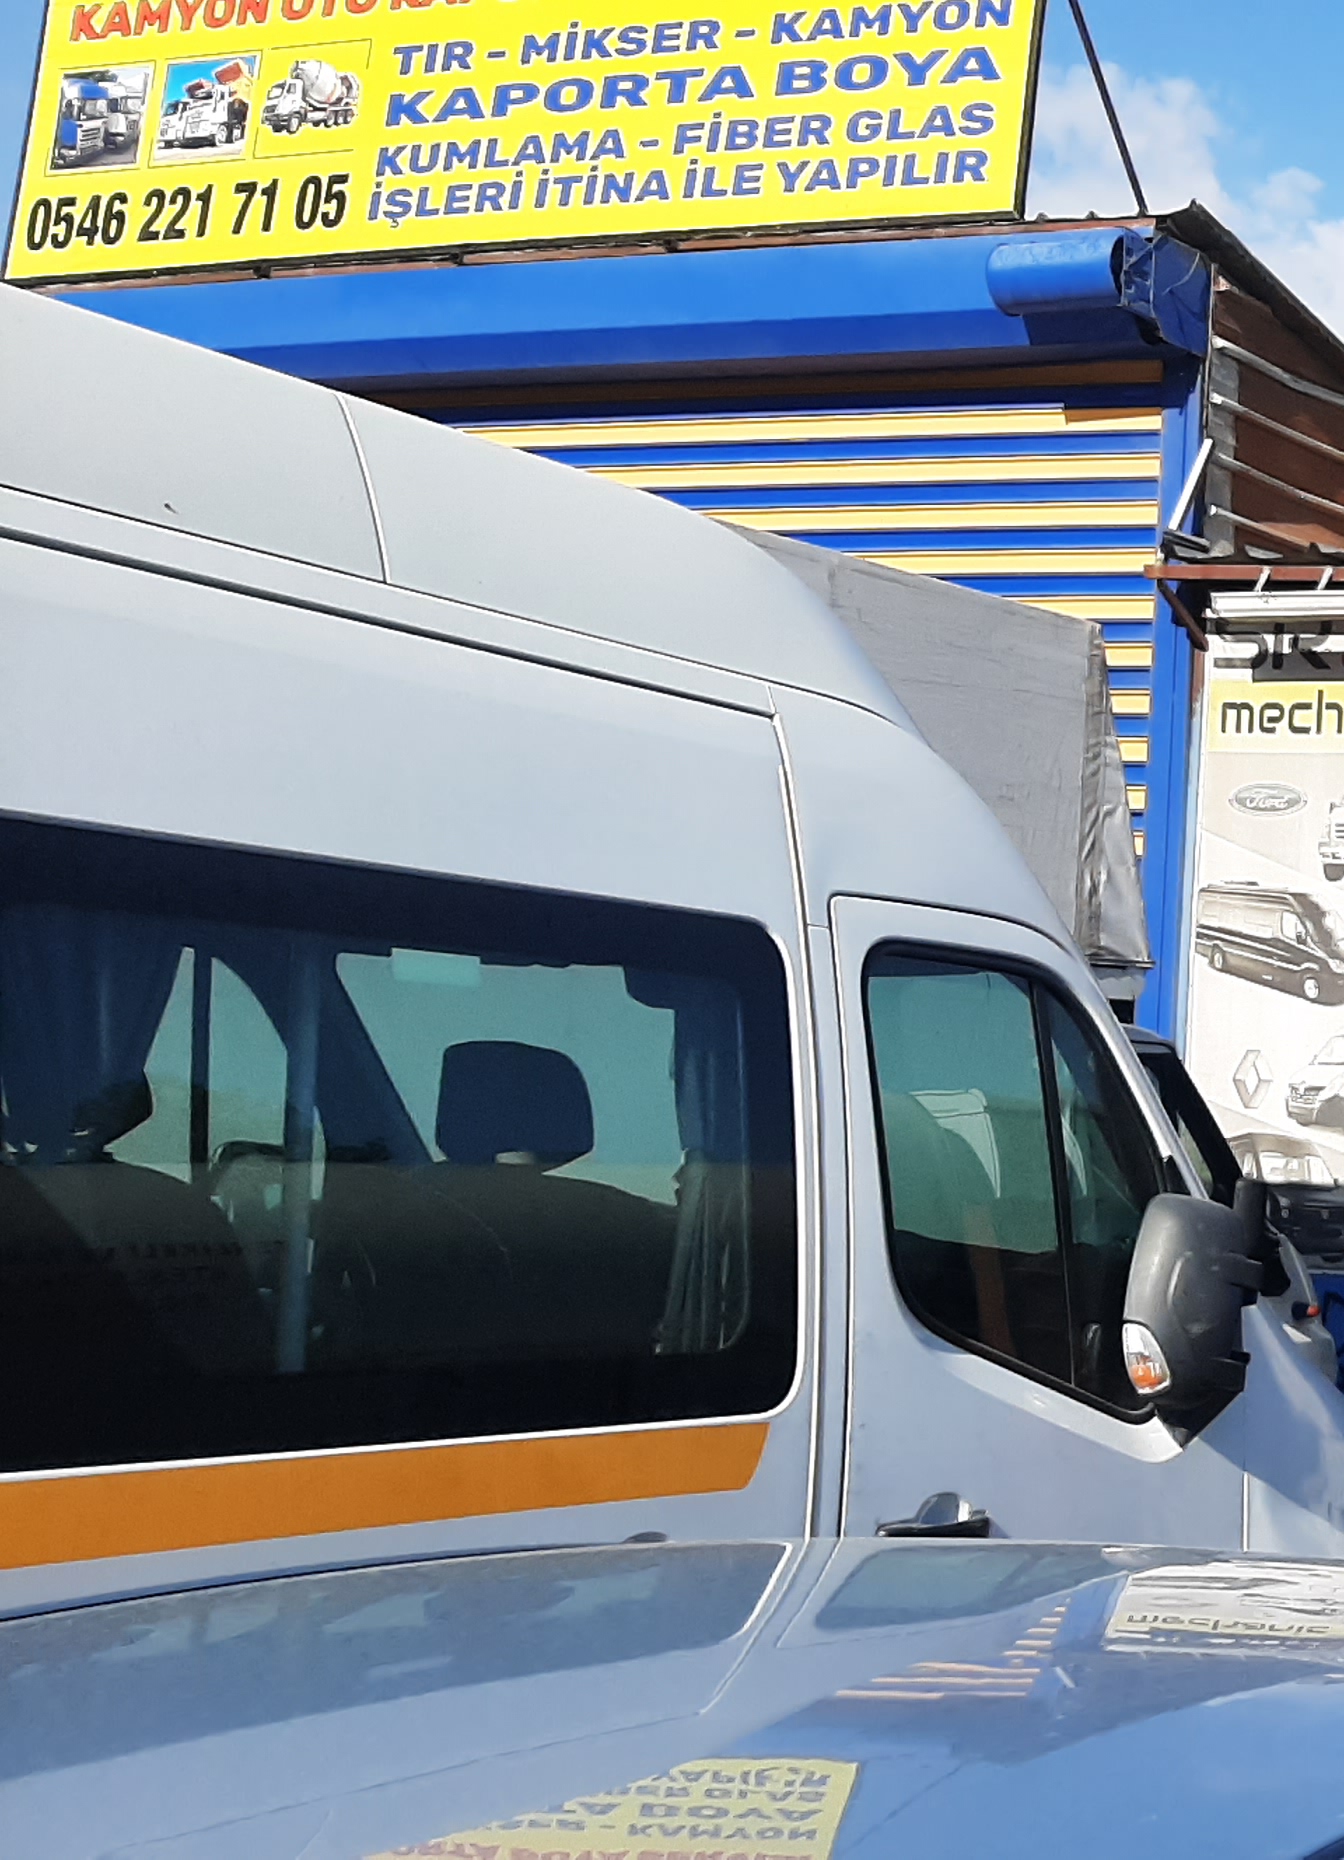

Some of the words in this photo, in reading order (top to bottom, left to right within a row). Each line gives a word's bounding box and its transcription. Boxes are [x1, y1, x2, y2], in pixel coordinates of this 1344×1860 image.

[70, 0, 270, 42] KAMYON
[394, 40, 476, 76] TIR
[521, 20, 721, 65] MİKSER
[770, 0, 1011, 44] KAMYON
[385, 65, 754, 126] KAPORTA
[775, 46, 1001, 96] BOYA
[375, 128, 625, 177] KUMLAMA
[673, 112, 832, 154] FİBER
[846, 102, 996, 142] GLAS
[27, 191, 128, 251] 0546
[137, 183, 214, 243] 221
[231, 178, 280, 235] 71
[294, 173, 350, 230] 05
[368, 168, 524, 228] İŞLERİ
[535, 165, 670, 209] İTİNA
[682, 158, 763, 199] İLE
[777, 150, 989, 192] YAPILIR
[1213, 617, 1333, 670] SR
